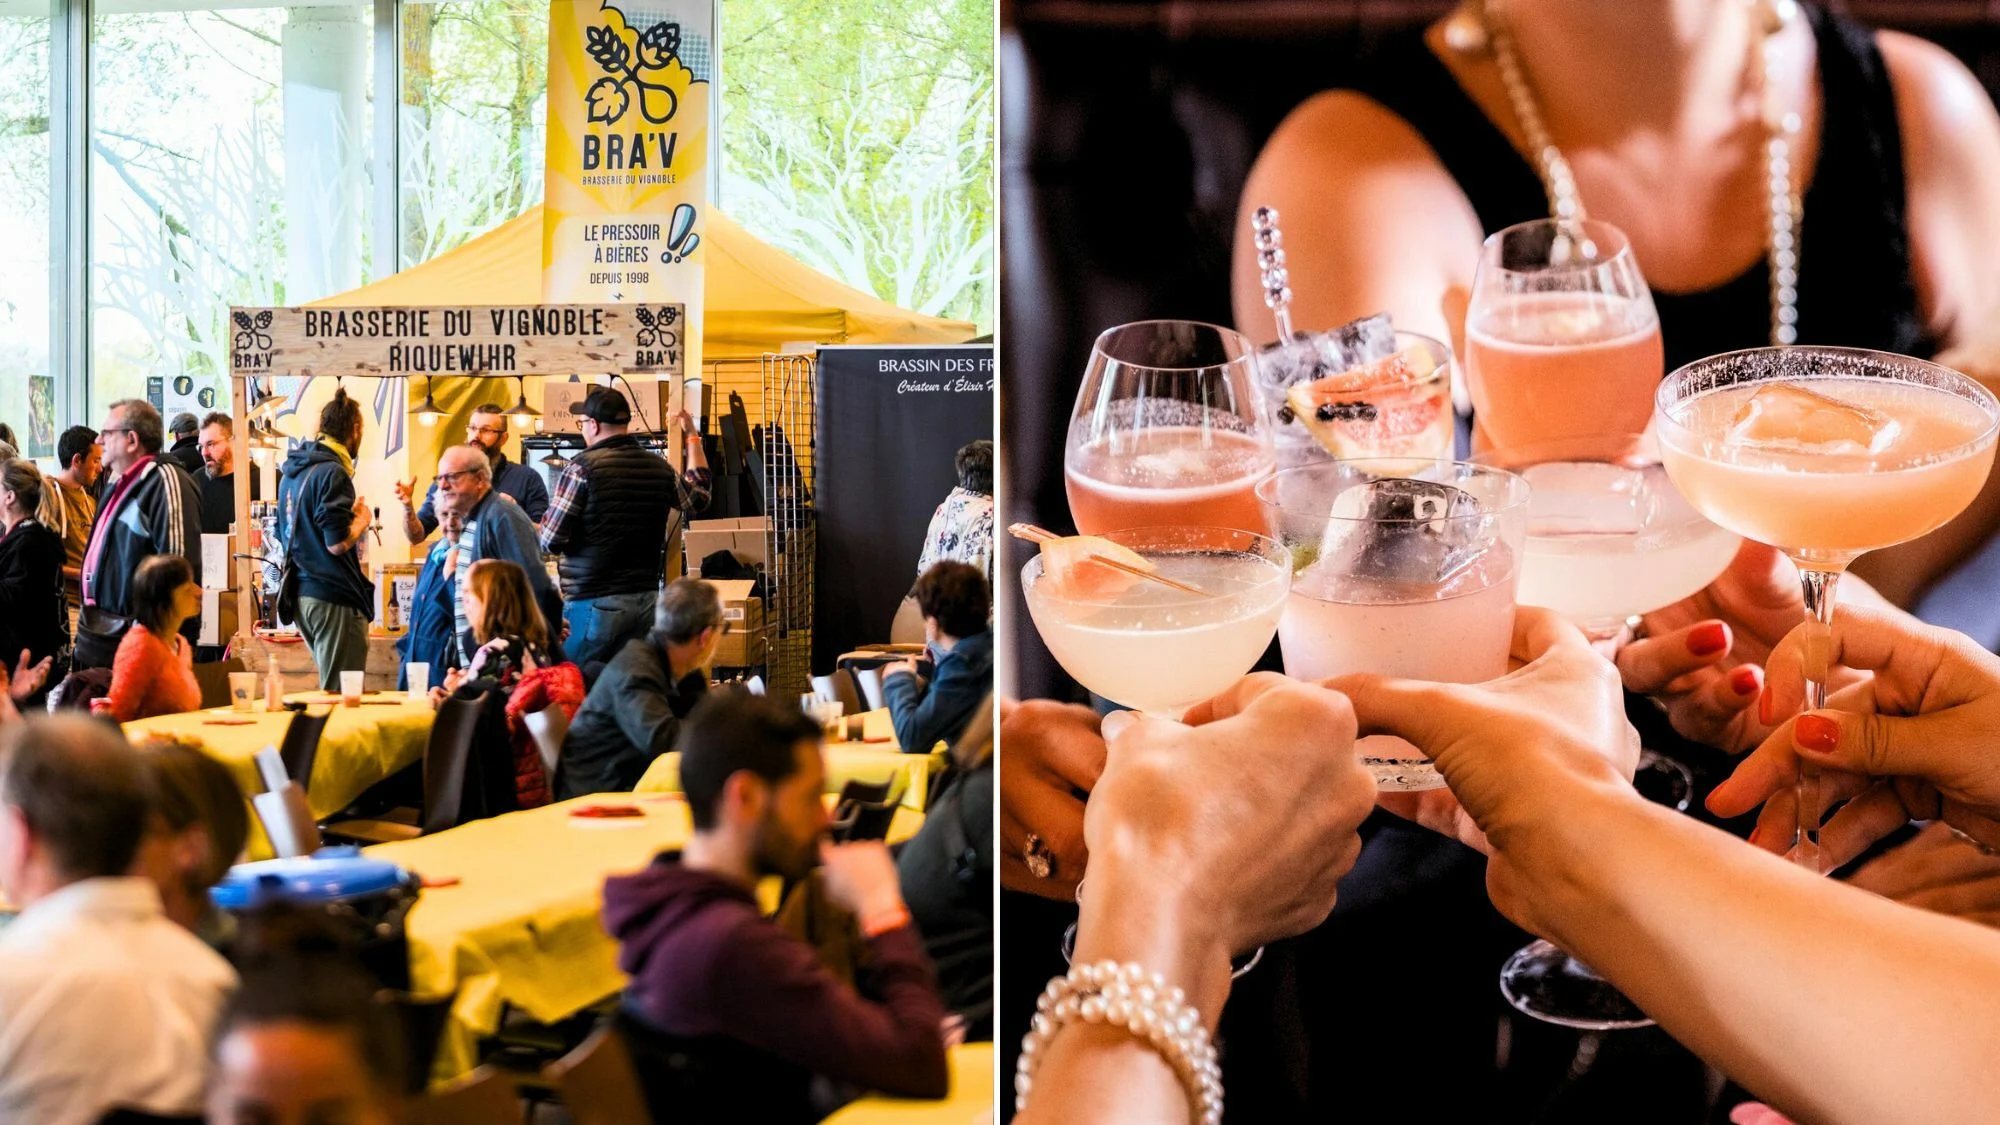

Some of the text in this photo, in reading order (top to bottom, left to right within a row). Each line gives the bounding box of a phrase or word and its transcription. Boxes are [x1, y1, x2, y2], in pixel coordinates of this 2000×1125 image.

[582, 174, 677, 186] BRASSERIE DU VIGNOBLE
[584, 223, 660, 242] LE PRESSOIR
[594, 242, 649, 263] À BIÈRES
[590, 271, 649, 285] DEPUIS 1998
[305, 308, 604, 338] BRASSERIE DU VIGNOBLE
[234, 352, 273, 368] BRA'V
[389, 344, 516, 371] RIQUEWIHR
[636, 350, 677, 366] BRA'V
[878, 359, 941, 373] BRASSIN
[945, 358, 975, 372] DES
[897, 379, 940, 394] Créateur
[943, 375, 984, 393] d'Élixir
